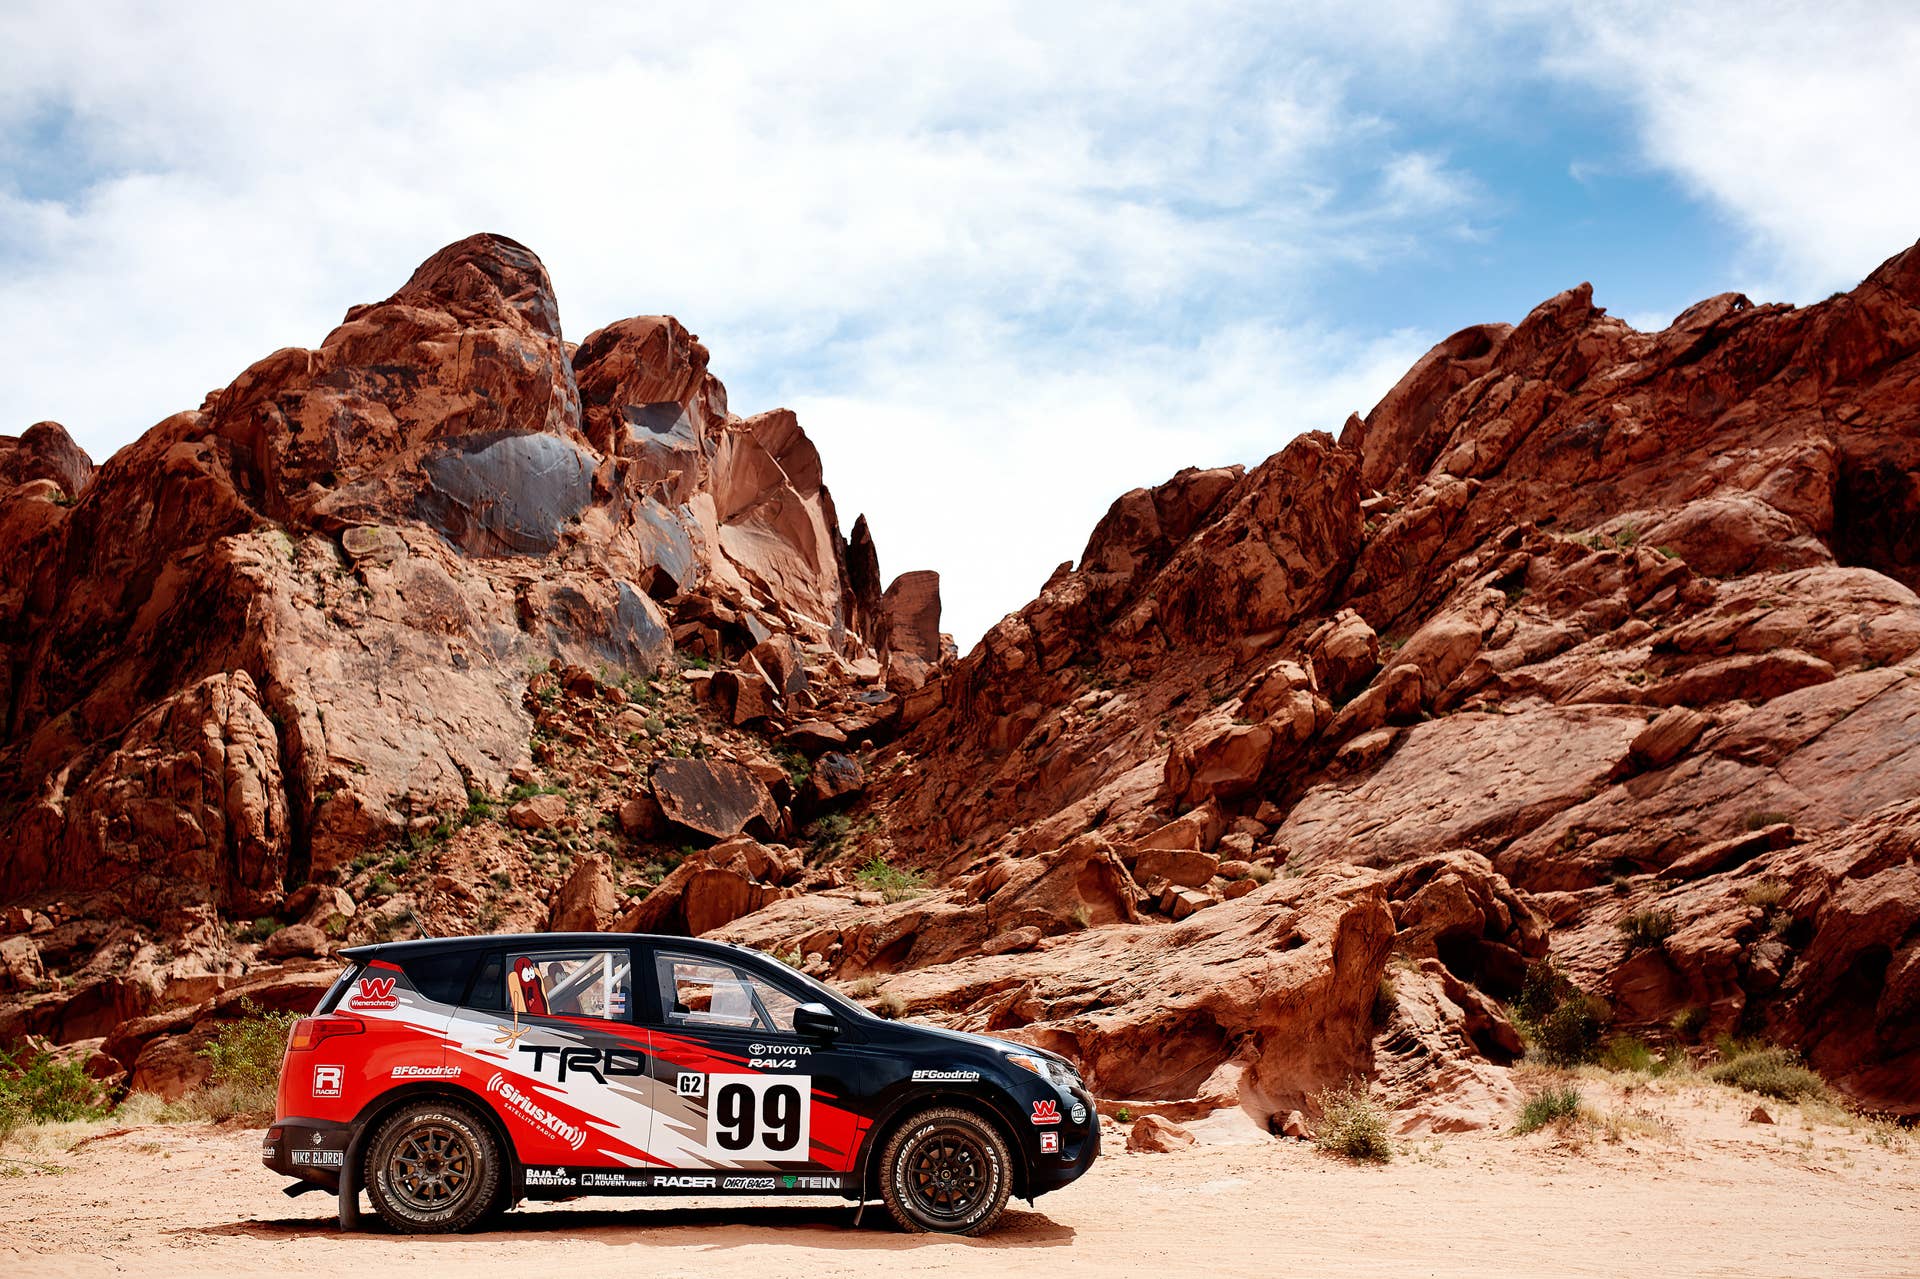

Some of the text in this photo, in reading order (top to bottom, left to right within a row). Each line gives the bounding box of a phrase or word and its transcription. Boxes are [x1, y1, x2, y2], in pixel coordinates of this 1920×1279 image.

[766, 1045, 812, 1055] TOYOTA
[519, 1045, 646, 1084] TRD
[748, 1059, 796, 1069] RAV4
[391, 1066, 461, 1076] BFGoodrich
[912, 1070, 980, 1079] BFGoodrich
[316, 1067, 341, 1089] R
[680, 1076, 702, 1093] G2
[504, 1103, 557, 1141] SATELLITE RADIO
[716, 1083, 802, 1151] 99
[291, 1151, 344, 1166] MIKE ELDRED
[526, 1169, 552, 1178] BAJA
[653, 1176, 717, 1188] RACER
[723, 1177, 746, 1189] DIRT
[798, 1176, 840, 1189] TEIN
